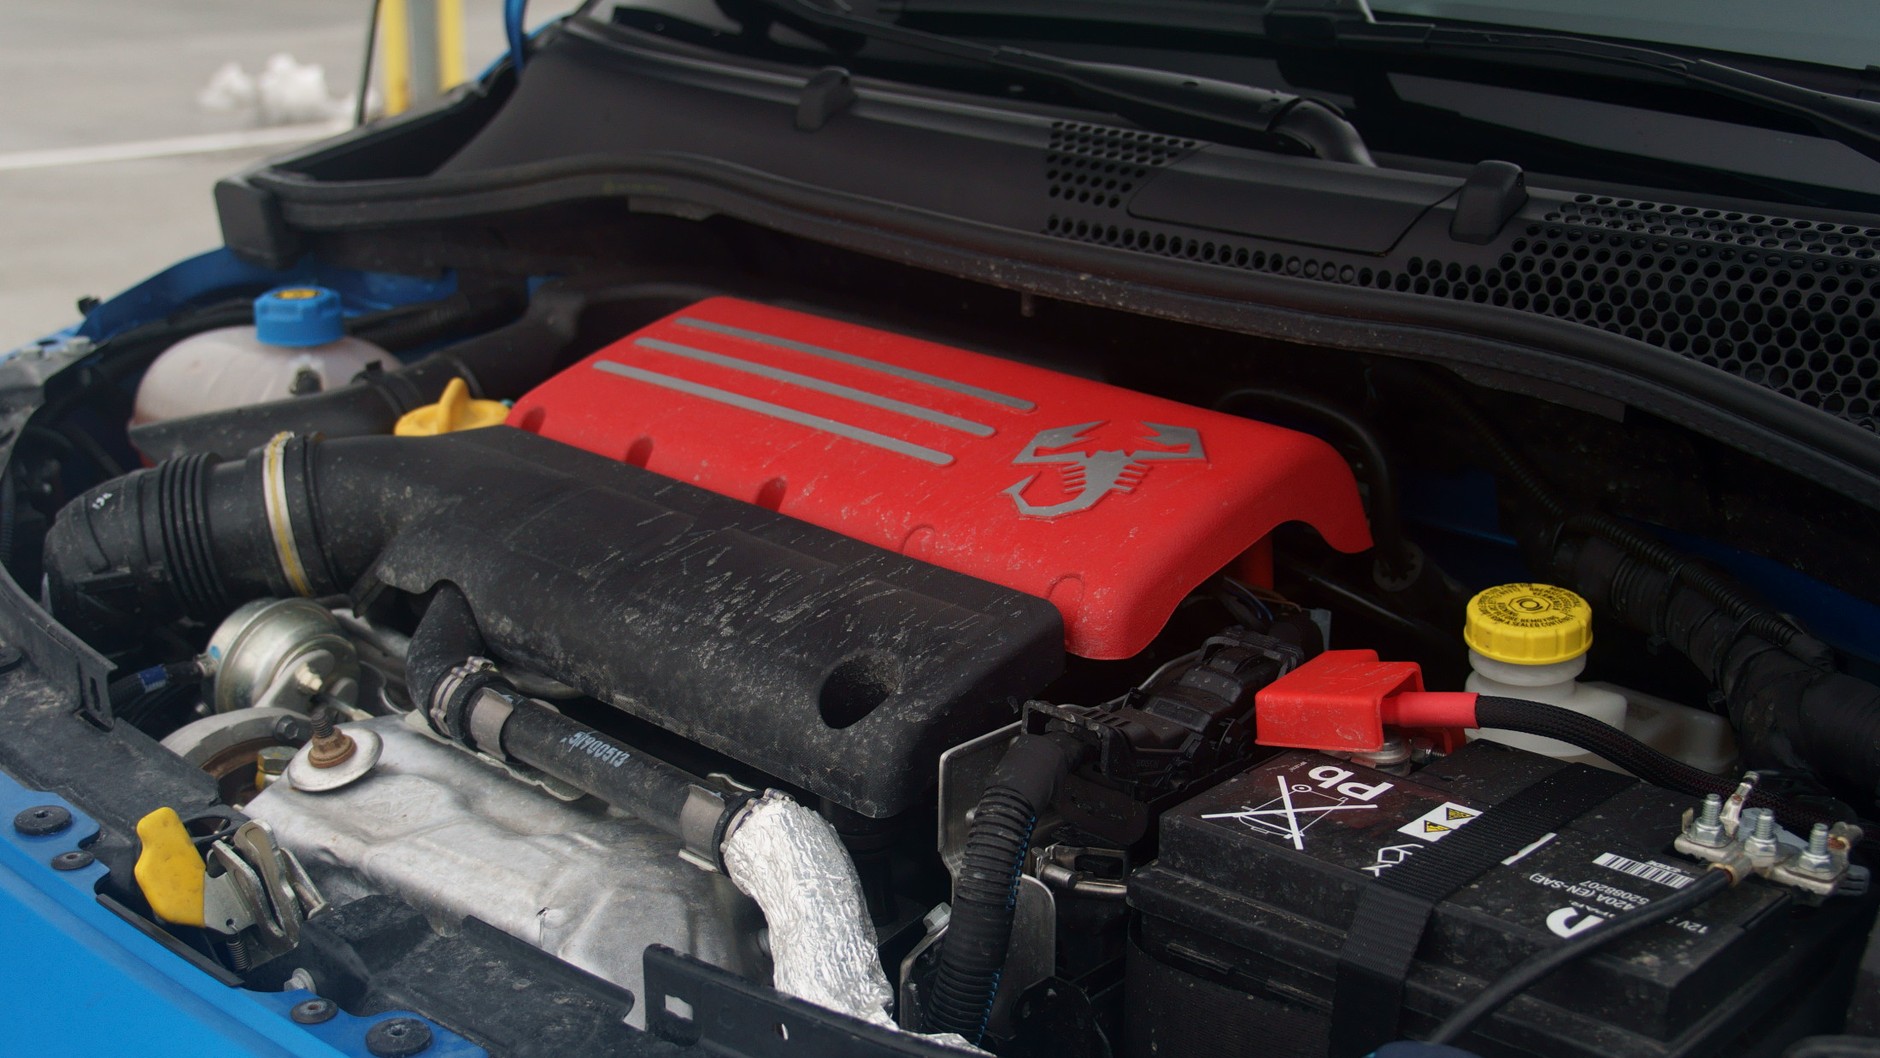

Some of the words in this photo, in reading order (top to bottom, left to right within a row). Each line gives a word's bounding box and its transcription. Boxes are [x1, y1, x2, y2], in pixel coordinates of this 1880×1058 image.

[1308, 765, 1395, 801] Pb
[1529, 872, 1597, 898] (EN-SAE)
[1579, 880, 1649, 905] 52088207
[1596, 893, 1636, 911] 420A
